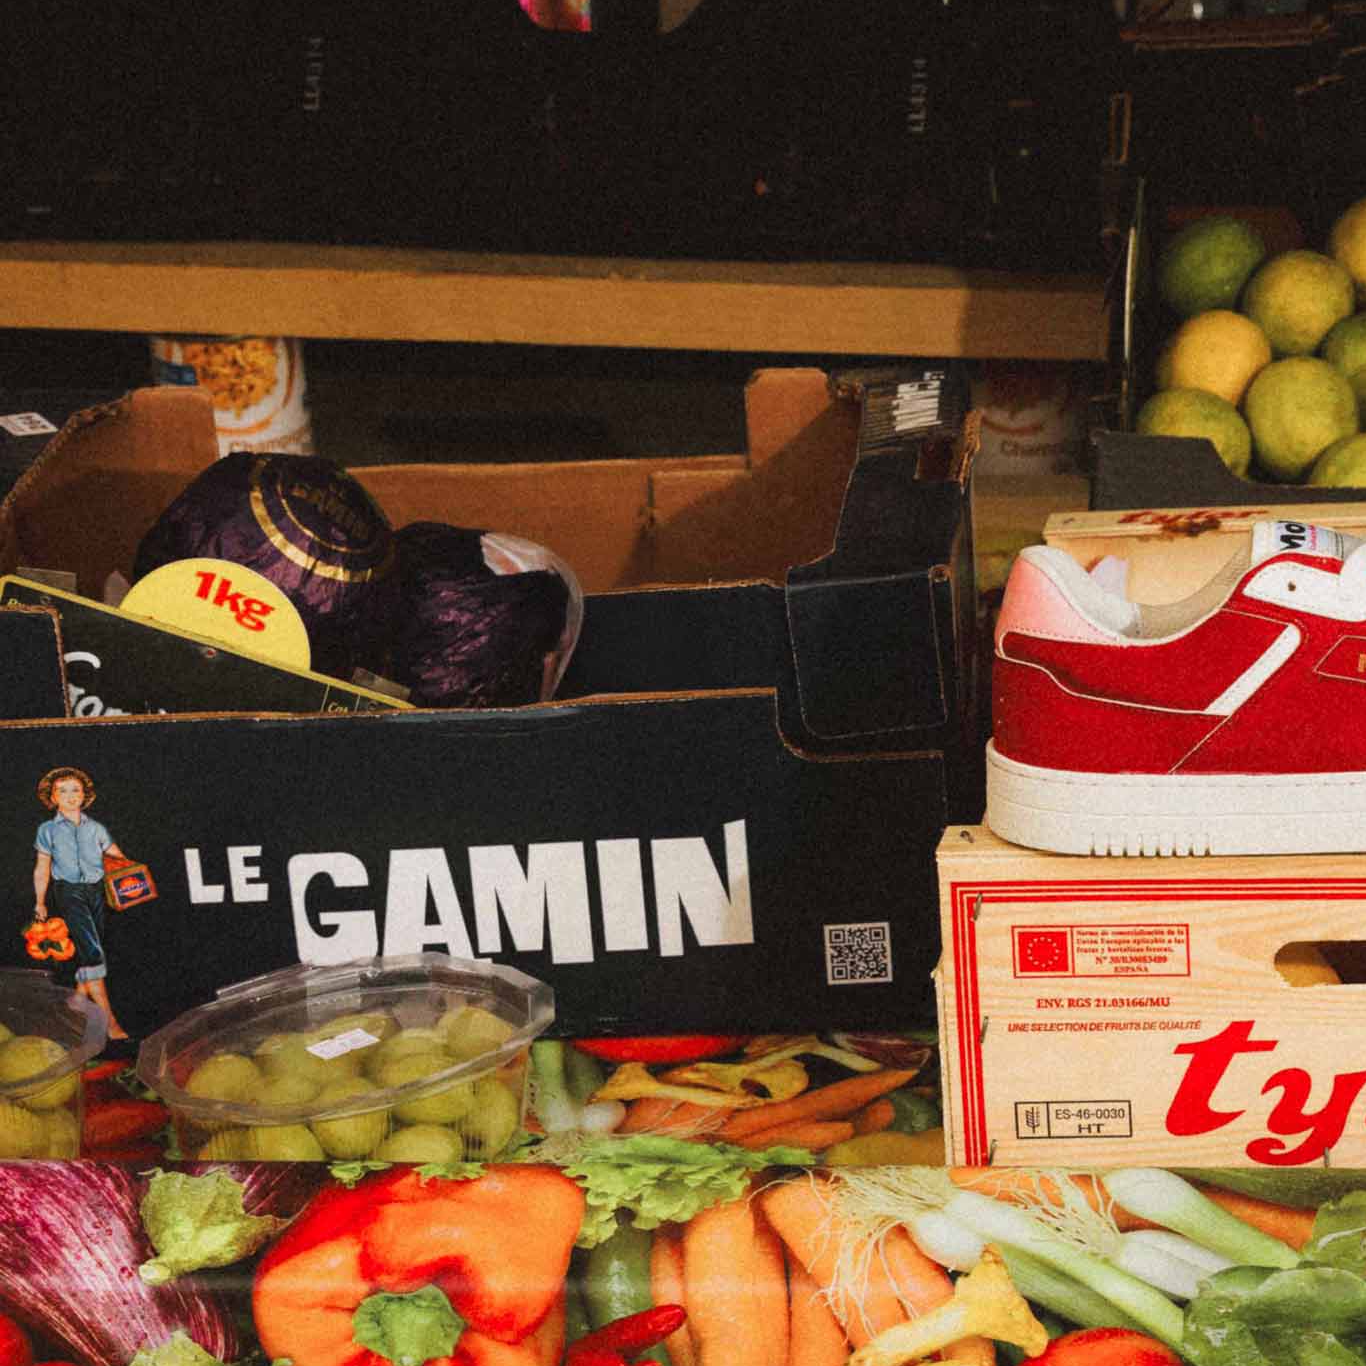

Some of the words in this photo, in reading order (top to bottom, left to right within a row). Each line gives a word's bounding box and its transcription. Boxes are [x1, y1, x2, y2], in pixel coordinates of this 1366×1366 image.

[195, 570, 276, 633] 1kg
[183, 844, 270, 904] LE
[286, 817, 755, 968] GAMIN
[1036, 998, 1064, 1009] ENV.
[1067, 997, 1092, 1009] RGS
[1008, 1022, 1030, 1033] UNE
[1031, 1021, 1089, 1033] SELECTION
[1089, 1021, 1105, 1032] DE
[1105, 1021, 1142, 1032] FRUITS
[1142, 1021, 1156, 1031] DE
[1055, 1108, 1126, 1120] ES-46-0030
[1078, 1123, 1105, 1134] HT
